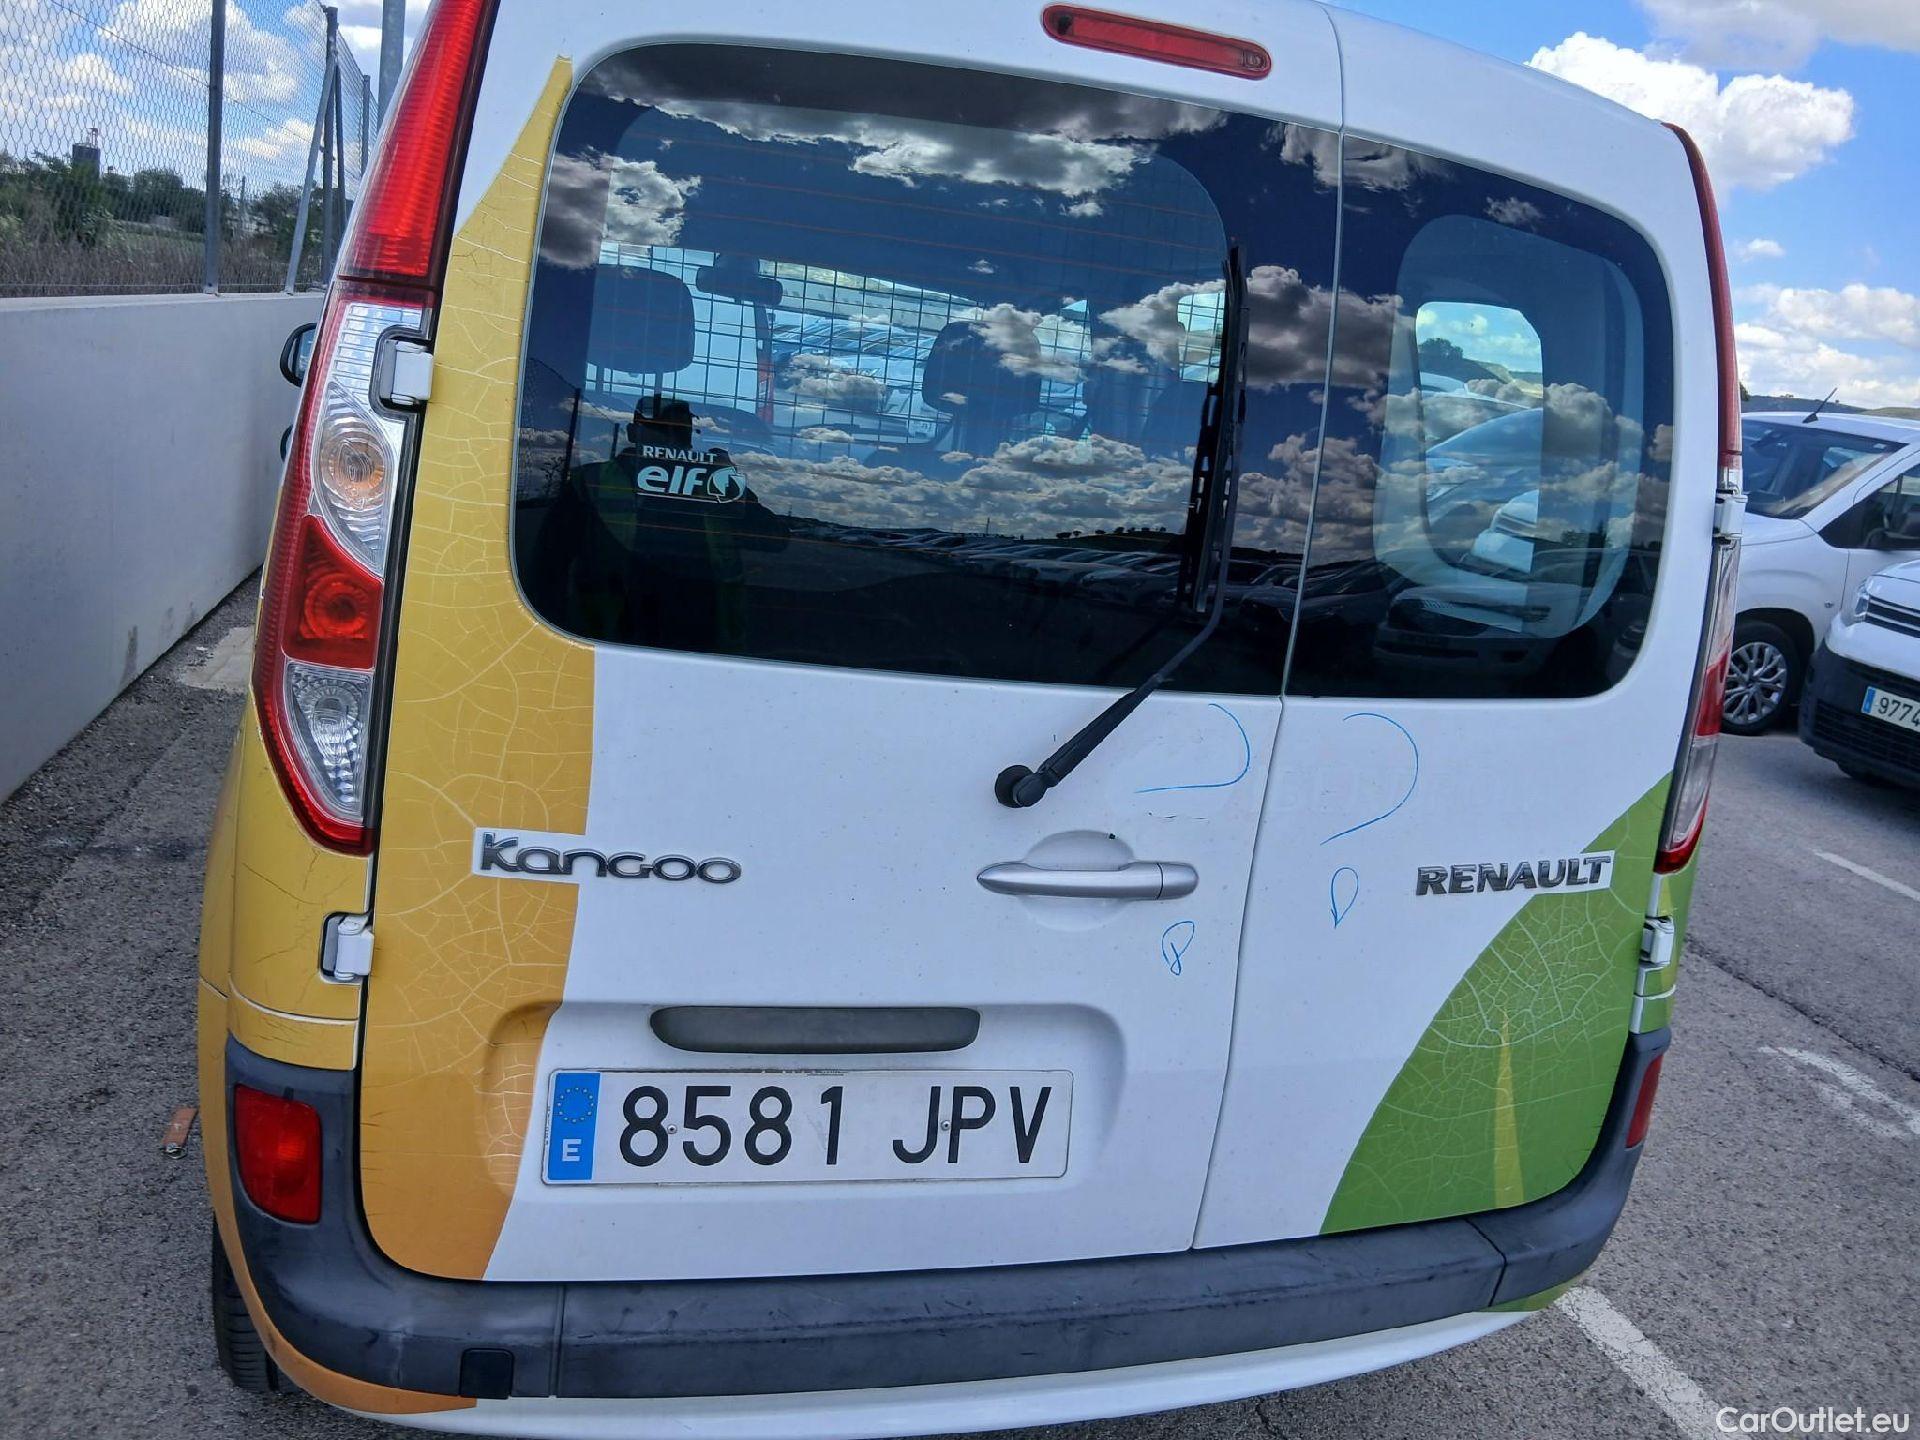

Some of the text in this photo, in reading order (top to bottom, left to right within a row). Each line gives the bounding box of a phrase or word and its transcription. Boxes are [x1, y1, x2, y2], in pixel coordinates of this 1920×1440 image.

[643, 445, 717, 465] RENAULT
[637, 465, 707, 496] elf
[480, 831, 742, 884] Kangoo
[1416, 856, 1611, 896] RENAULT
[619, 1086, 845, 1168] 8581
[892, 1086, 1052, 1164] JPV
[562, 1138, 581, 1162] E
